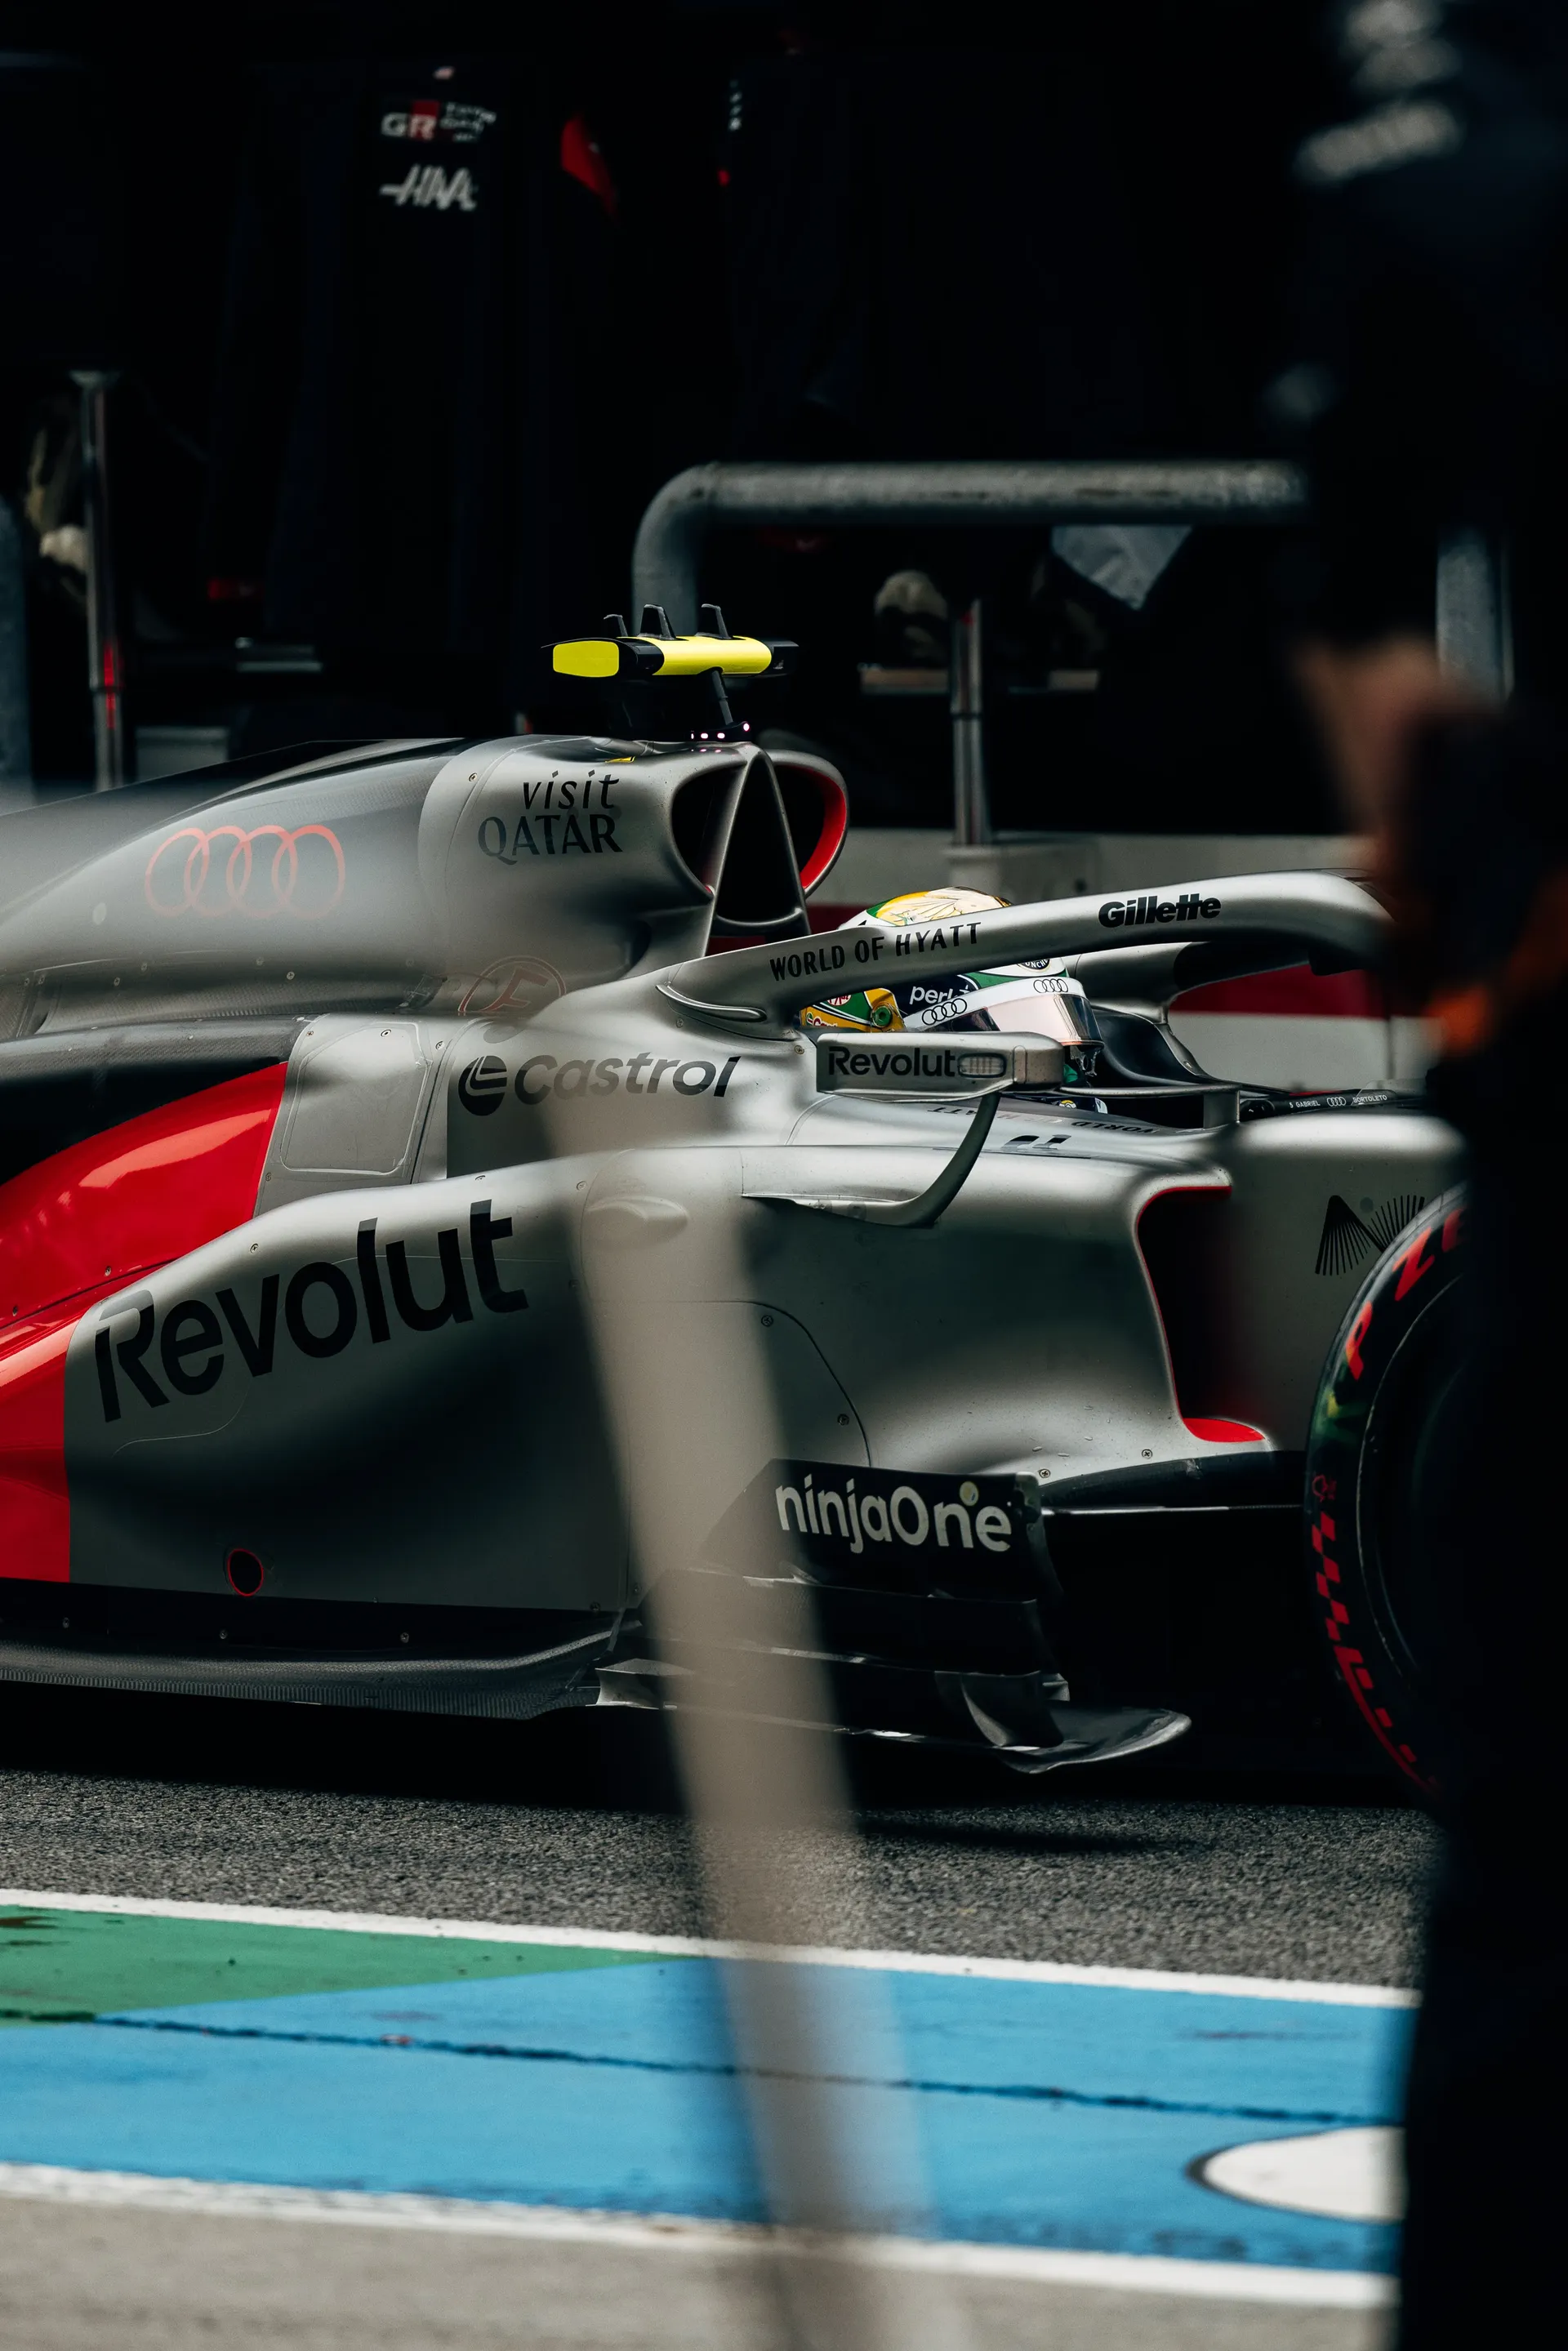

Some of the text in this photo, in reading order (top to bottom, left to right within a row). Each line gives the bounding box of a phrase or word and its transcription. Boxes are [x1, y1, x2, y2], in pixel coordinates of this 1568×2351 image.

[381, 111, 438, 141] GR
[523, 769, 620, 809] visit
[478, 813, 623, 866] QATAR
[1098, 893, 1222, 928] Gillette
[769, 922, 981, 982] WORLD OF HYATT
[514, 1052, 742, 1105] Castrol
[828, 1046, 956, 1076] Revolut
[1295, 1100, 1321, 1108] GABRIEL
[1352, 1094, 1388, 1103] BORTOLETO
[95, 1199, 529, 1423] Revolut
[776, 1473, 1012, 1553] ninjaOne
